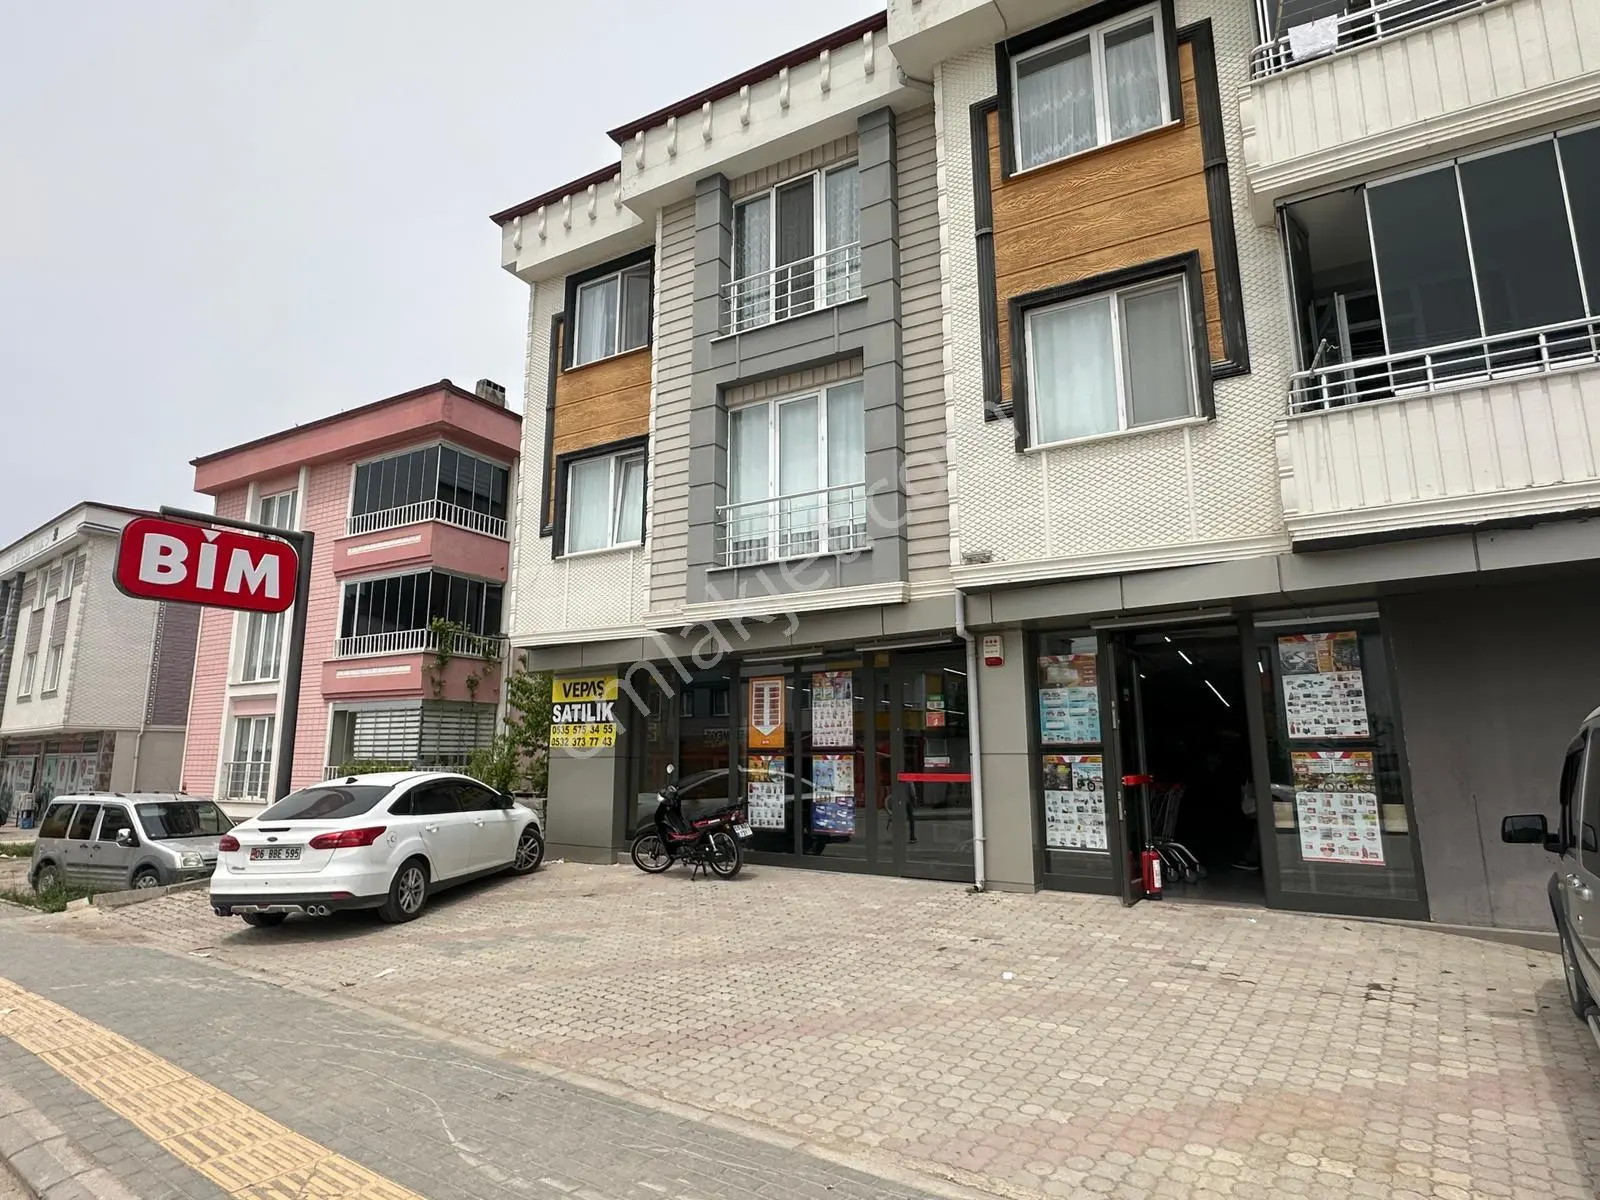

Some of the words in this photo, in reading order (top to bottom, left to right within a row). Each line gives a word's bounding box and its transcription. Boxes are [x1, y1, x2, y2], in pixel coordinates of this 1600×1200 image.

[139, 528, 280, 599] BİM
[552, 702, 614, 723] SATILIK
[572, 725, 586, 734] 575
[590, 725, 600, 734] 34
[603, 724, 613, 734] 55
[572, 737, 586, 747] 373
[589, 737, 599, 747] 77
[602, 737, 612, 746] 43
[284, 848, 299, 858] 595
